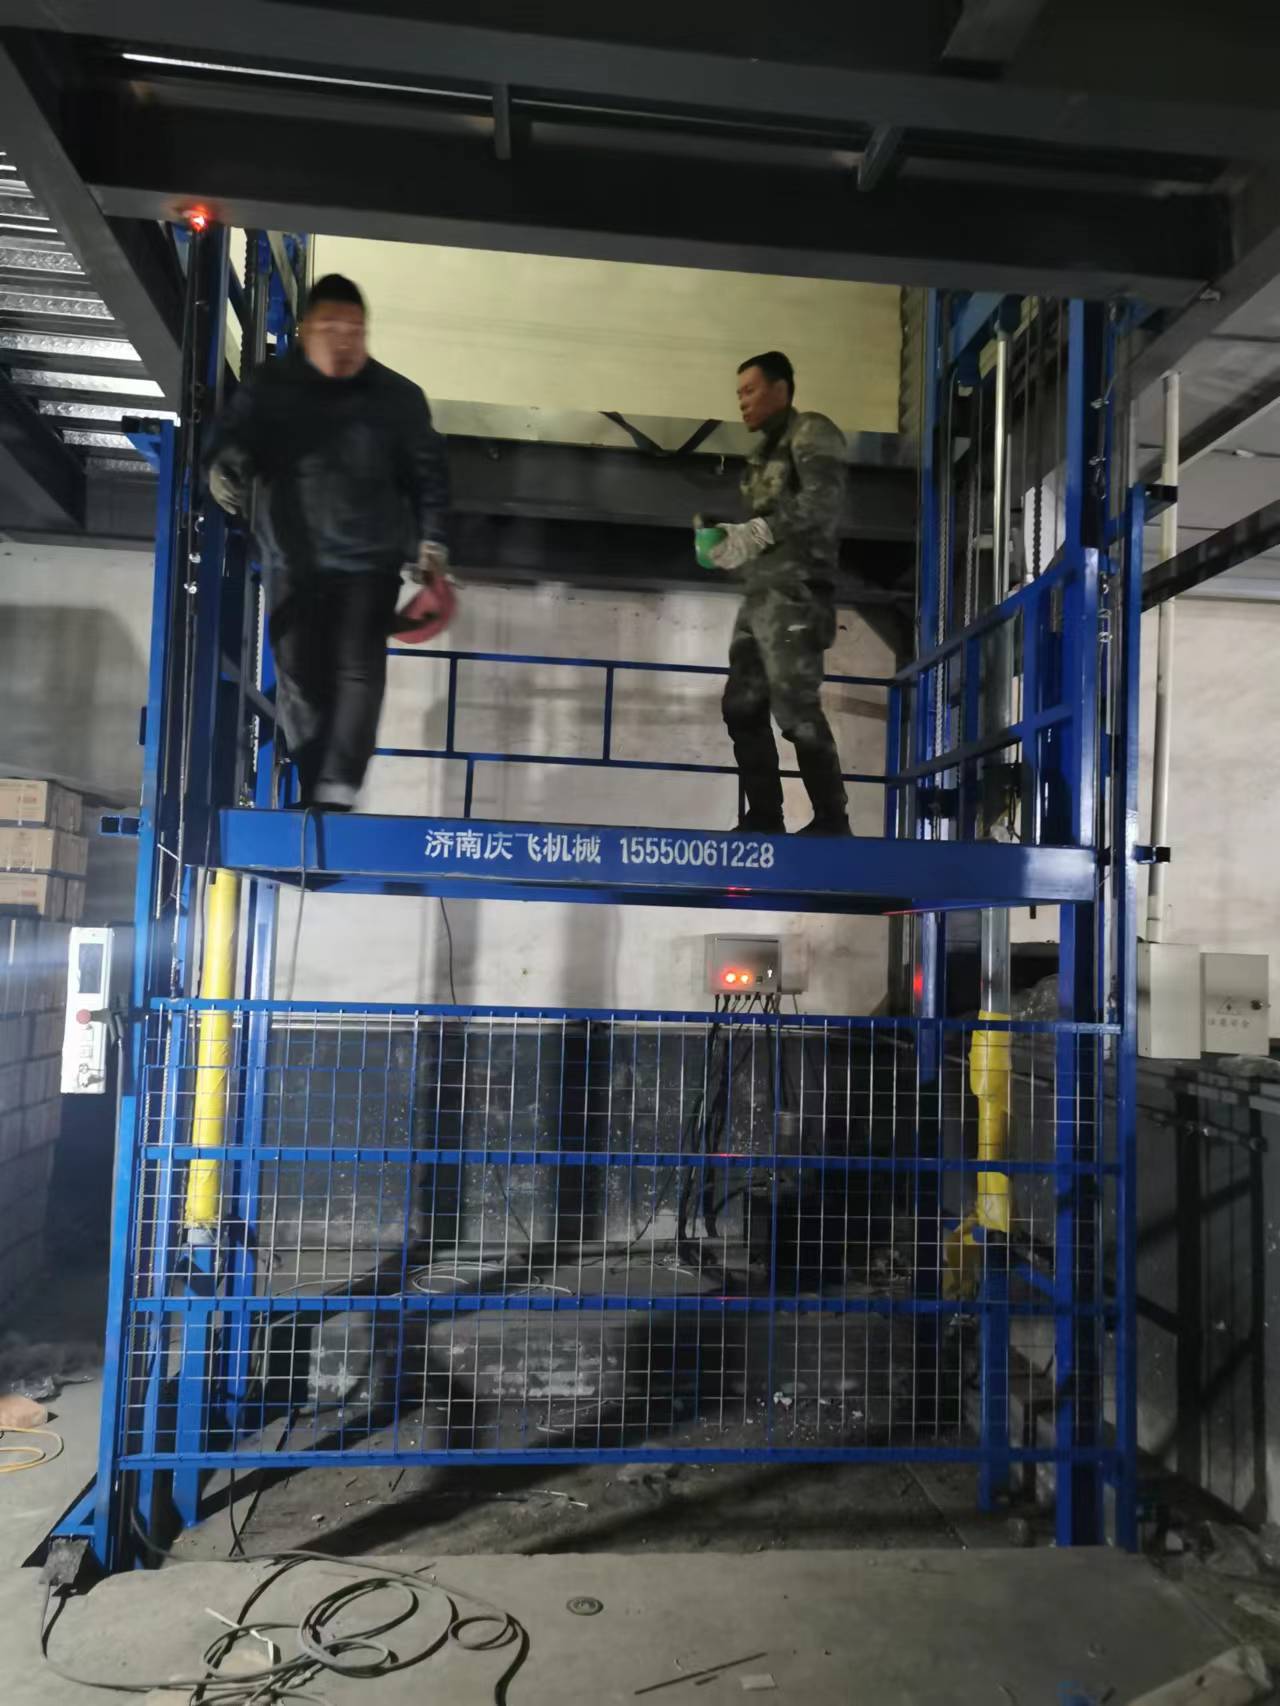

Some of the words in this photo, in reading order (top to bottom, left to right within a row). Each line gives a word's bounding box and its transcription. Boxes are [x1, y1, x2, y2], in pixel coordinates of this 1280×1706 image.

[424, 828, 602, 864] 济南庆飞机械
[620, 837, 775, 869] 15550061228
